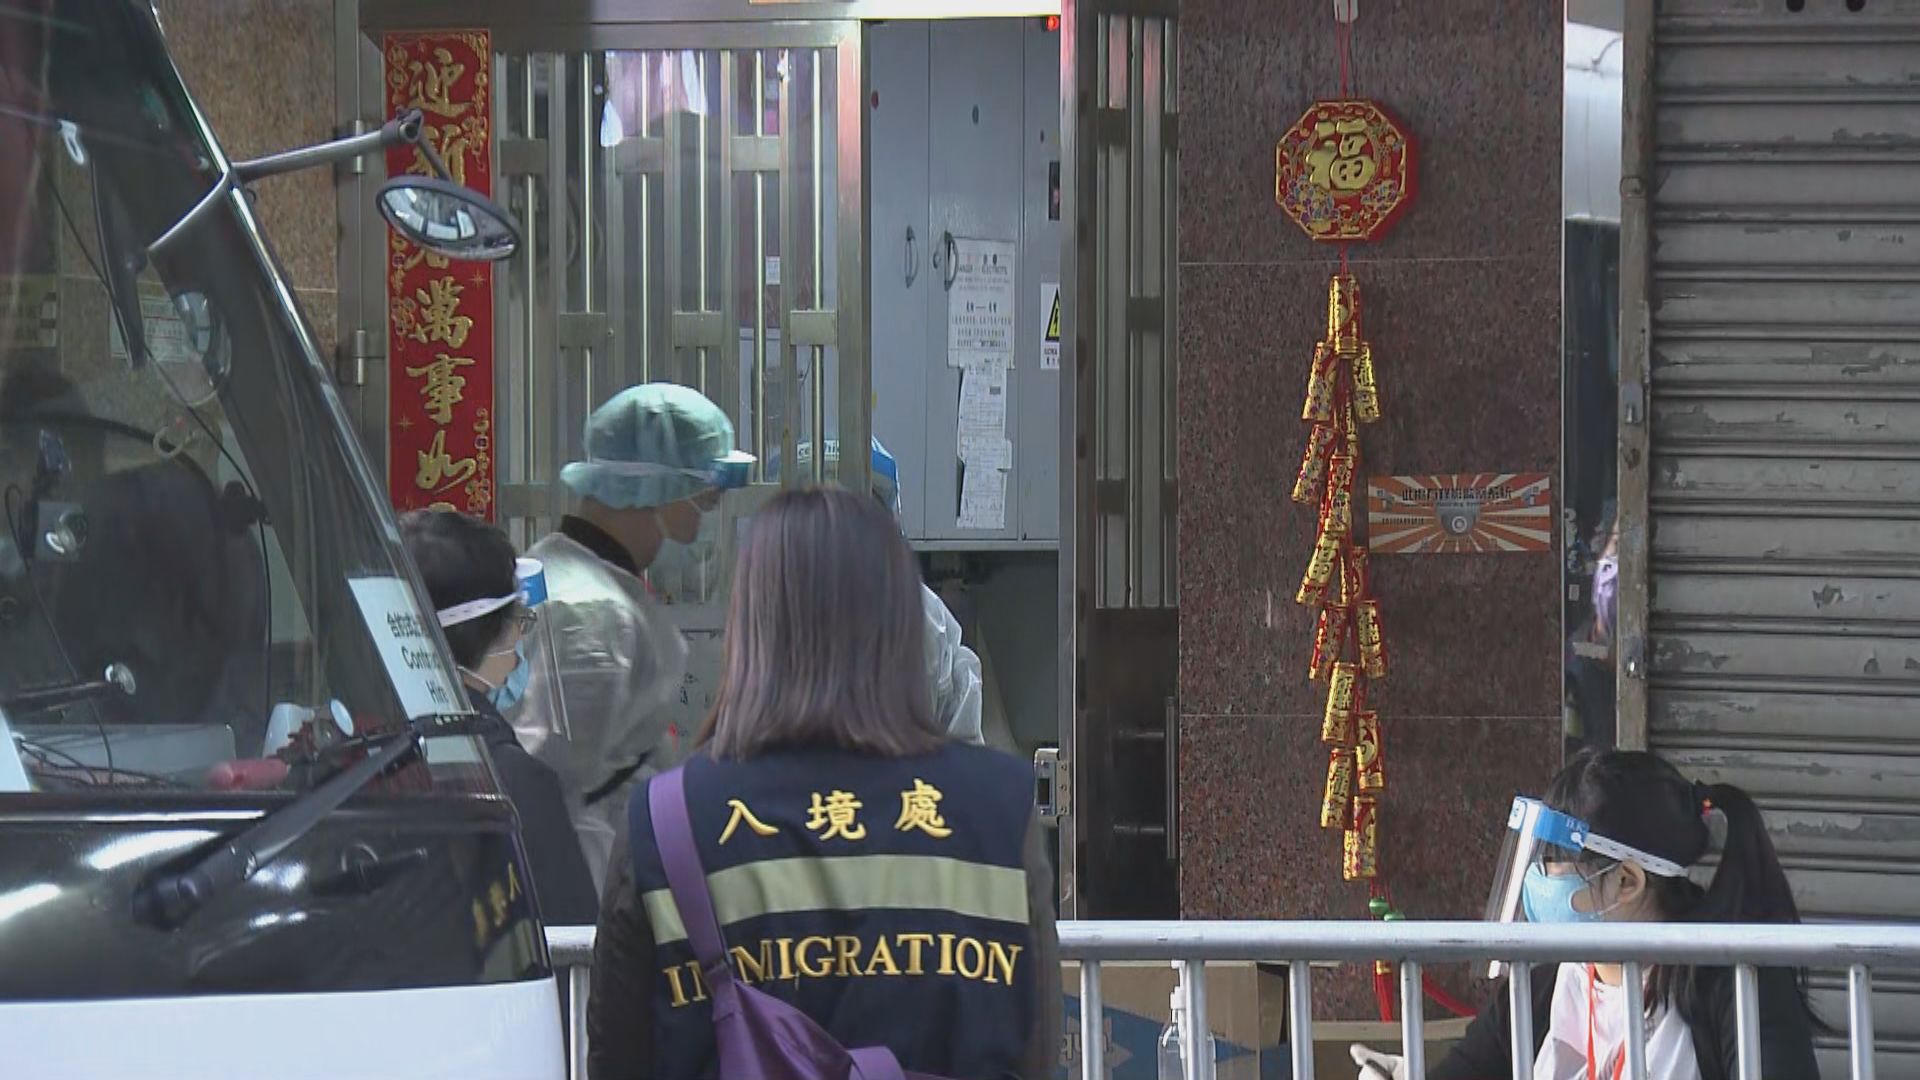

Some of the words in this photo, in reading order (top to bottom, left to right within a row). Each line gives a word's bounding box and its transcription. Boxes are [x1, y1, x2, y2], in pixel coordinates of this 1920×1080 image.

[1305, 118, 1376, 192] 福
[407, 49, 476, 512] 迎新萬事如
[718, 778, 953, 846] 入境處
